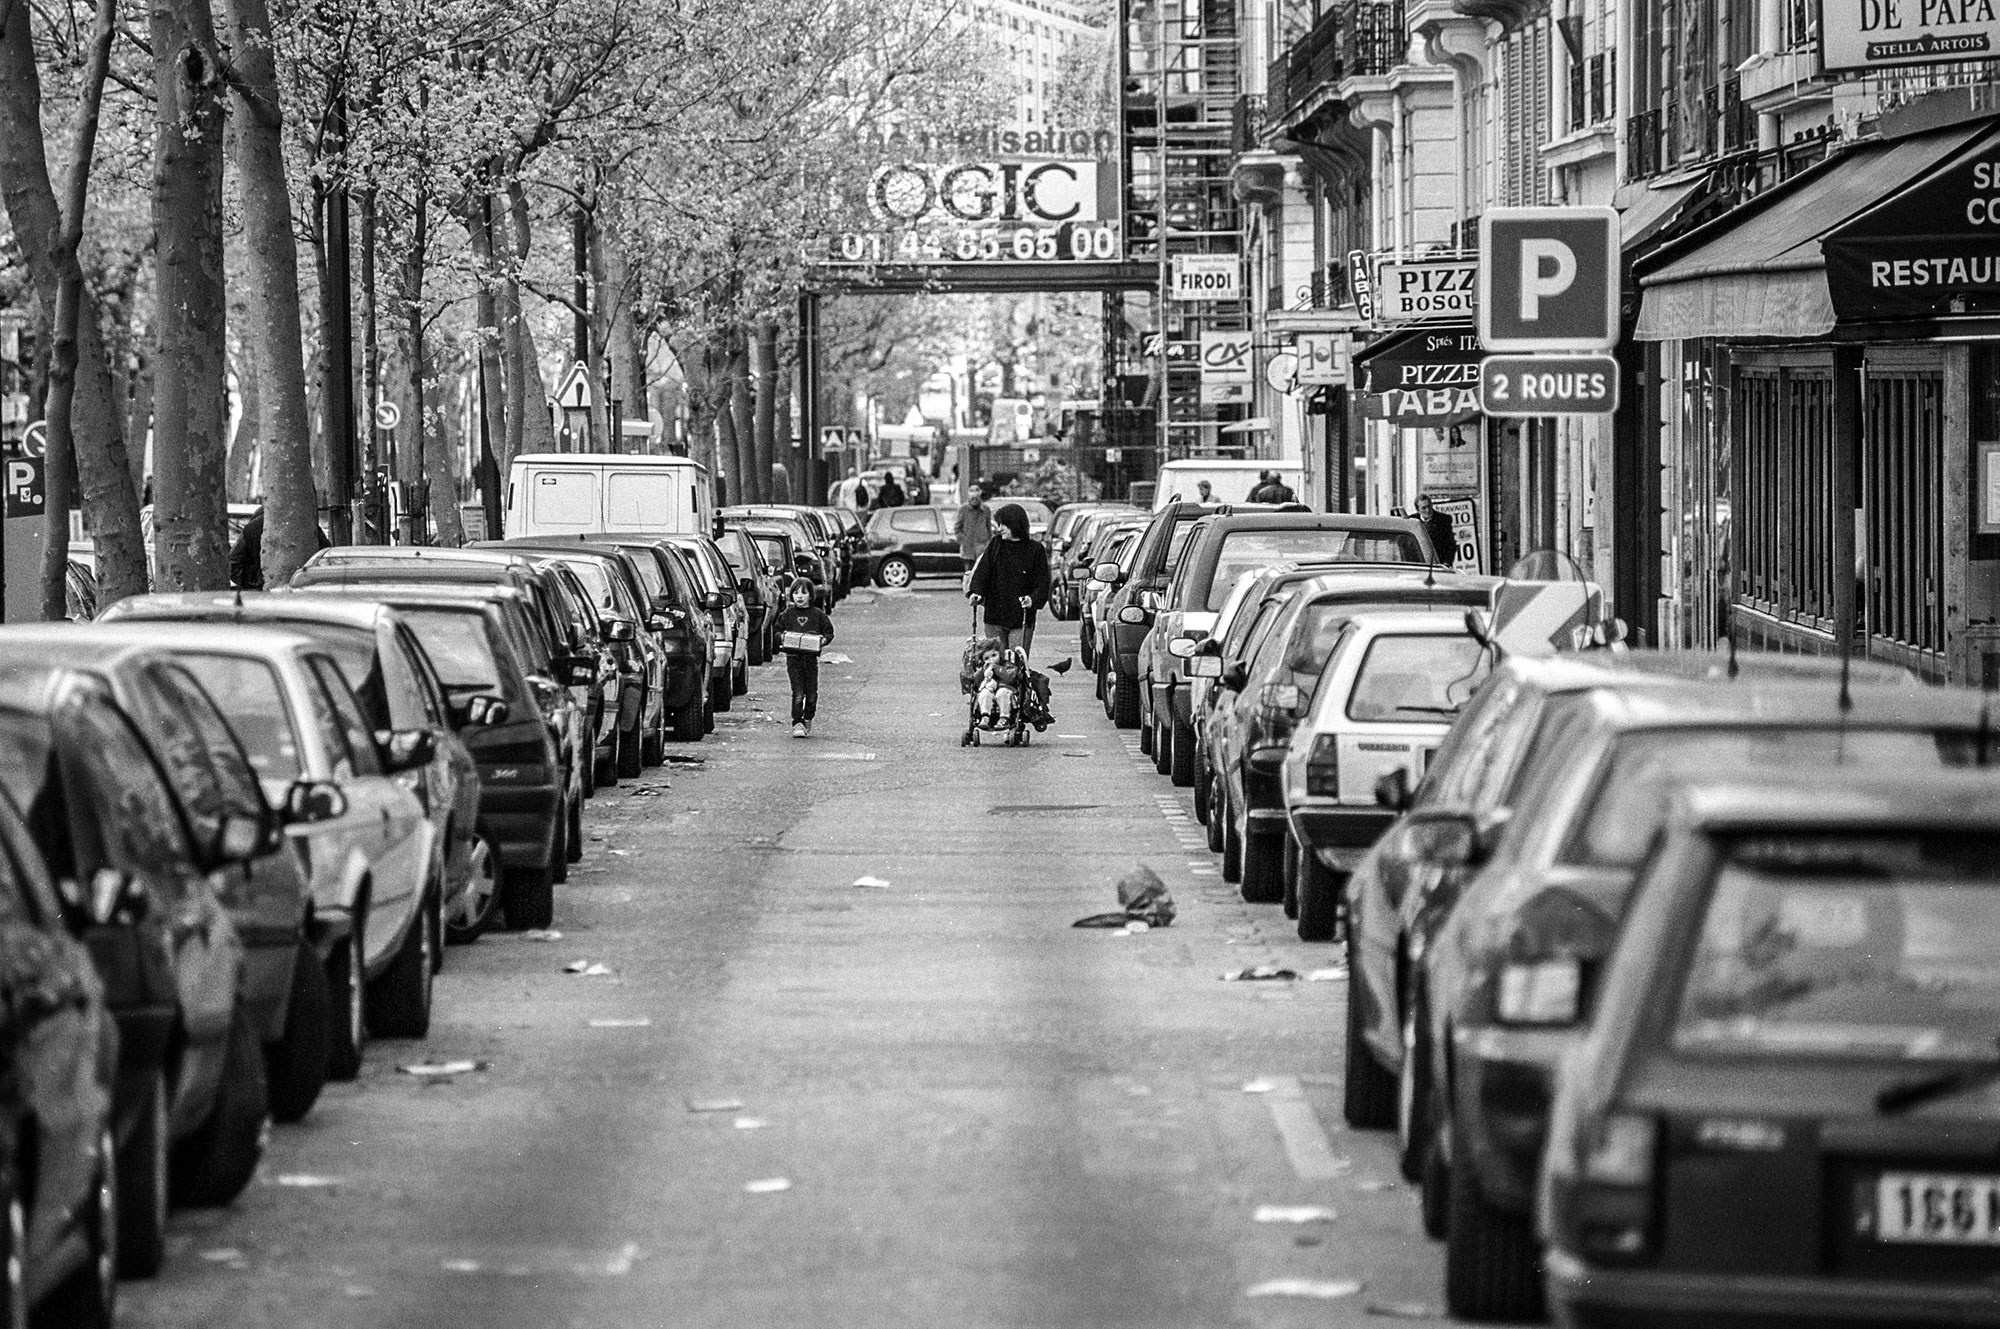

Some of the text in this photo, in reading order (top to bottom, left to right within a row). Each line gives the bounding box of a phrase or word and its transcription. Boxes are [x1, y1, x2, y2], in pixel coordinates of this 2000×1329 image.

[1861, 0, 1996, 31] DE PAPA
[1873, 36, 1984, 56] STELLA ARTOIS
[875, 162, 1081, 221] OGIC
[842, 231, 880, 260] 01
[1012, 227, 1058, 260] 65
[1070, 226, 1115, 260] 00
[1181, 273, 1231, 289] FIRODI
[1520, 238, 1577, 321] P
[1492, 373, 1606, 400] 2 ROUES
[8, 461, 35, 495] P
